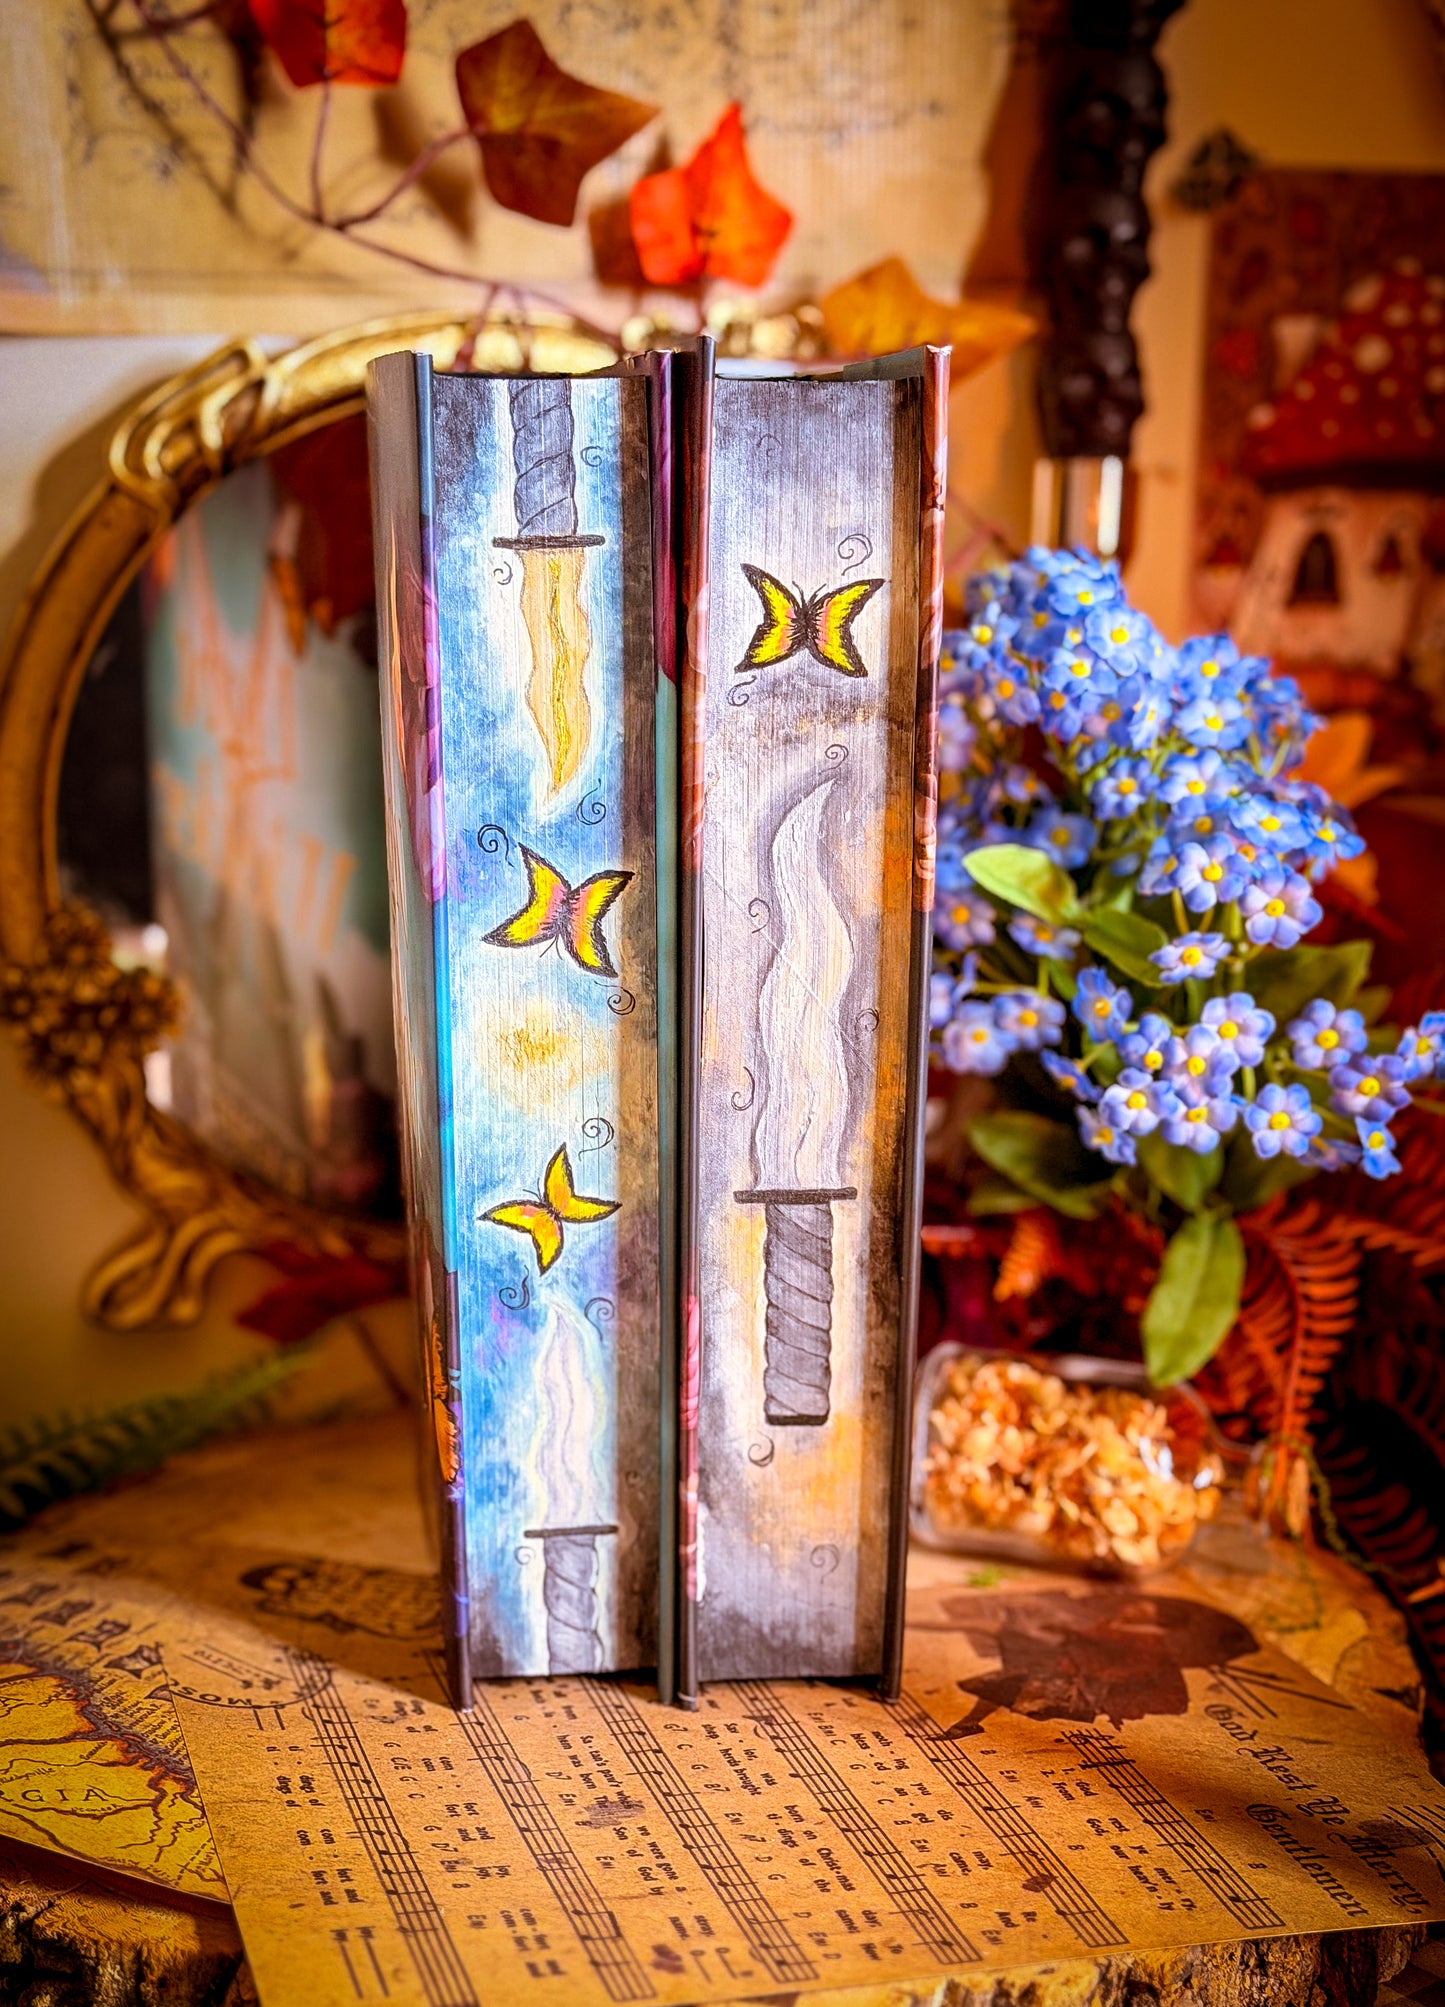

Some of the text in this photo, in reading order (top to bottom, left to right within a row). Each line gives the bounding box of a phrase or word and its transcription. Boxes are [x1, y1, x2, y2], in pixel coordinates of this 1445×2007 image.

[457, 1828, 477, 1842] and
[475, 1826, 496, 1841] and
[568, 1754, 584, 1768] was
[580, 1772, 597, 1789] born
[612, 1826, 629, 1841] Son
[625, 1849, 644, 1857] of
[637, 1866, 659, 1882] God
[648, 1886, 665, 1896] by
[637, 1825, 651, 1836] we
[733, 1768, 762, 1796] brought
[799, 1858, 817, 1866] of
[814, 1879, 831, 1893] the
[760, 1773, 778, 1786] was
[784, 1804, 805, 1823] born
[803, 1830, 818, 1840] on
[910, 1782, 932, 1796] you
[972, 1851, 994, 1871] may,
[1052, 1782, 1075, 1800] From
[1086, 1818, 1110, 1836] God,
[1110, 1845, 1130, 1860] our
[1076, 1782, 1099, 1797] God
[1108, 1818, 1130, 1832] rest
[1128, 1845, 1149, 1854] ye
[1204, 1704, 1429, 1914] God Rest Ye Merry,
[647, 1841, 666, 1860] were
[656, 1862, 679, 1880] gone
[1246, 1803, 1369, 1916] Gentlemen
[949, 1852, 972, 1876] came,
[994, 1911, 1020, 1928] And
